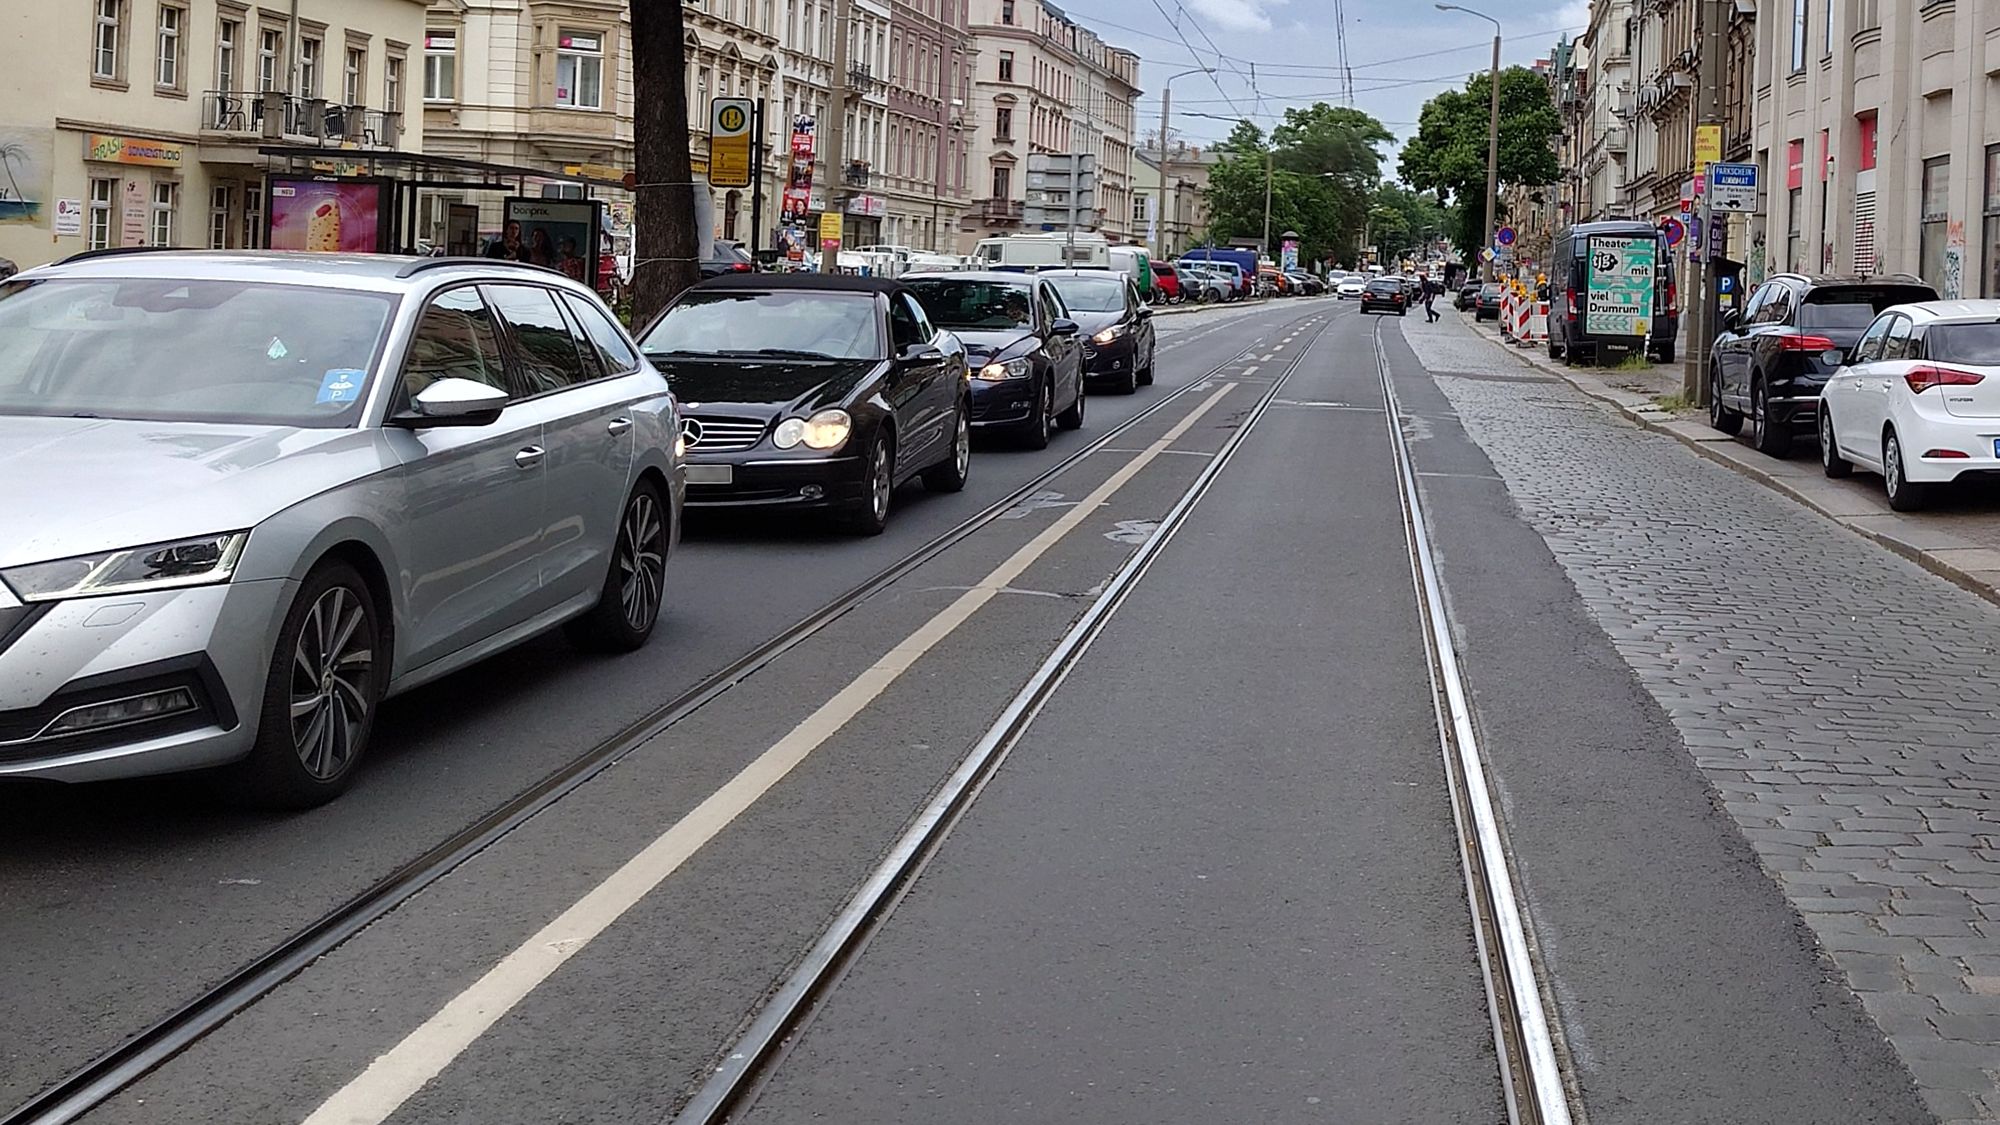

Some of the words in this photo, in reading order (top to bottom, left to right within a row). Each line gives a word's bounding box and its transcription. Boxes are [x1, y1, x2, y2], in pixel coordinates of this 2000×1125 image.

[94, 137, 125, 160] BRASIL
[128, 145, 181, 161] SONNENSTUDIO
[1716, 167, 1755, 175] PARKSCHEIN-
[1592, 238, 1632, 248] Theater
[1631, 265, 1649, 276] mit
[1721, 277, 1731, 291] P
[1590, 291, 1609, 301] viel
[1589, 303, 1640, 314] Drumrum
[331, 390, 342, 401] P
